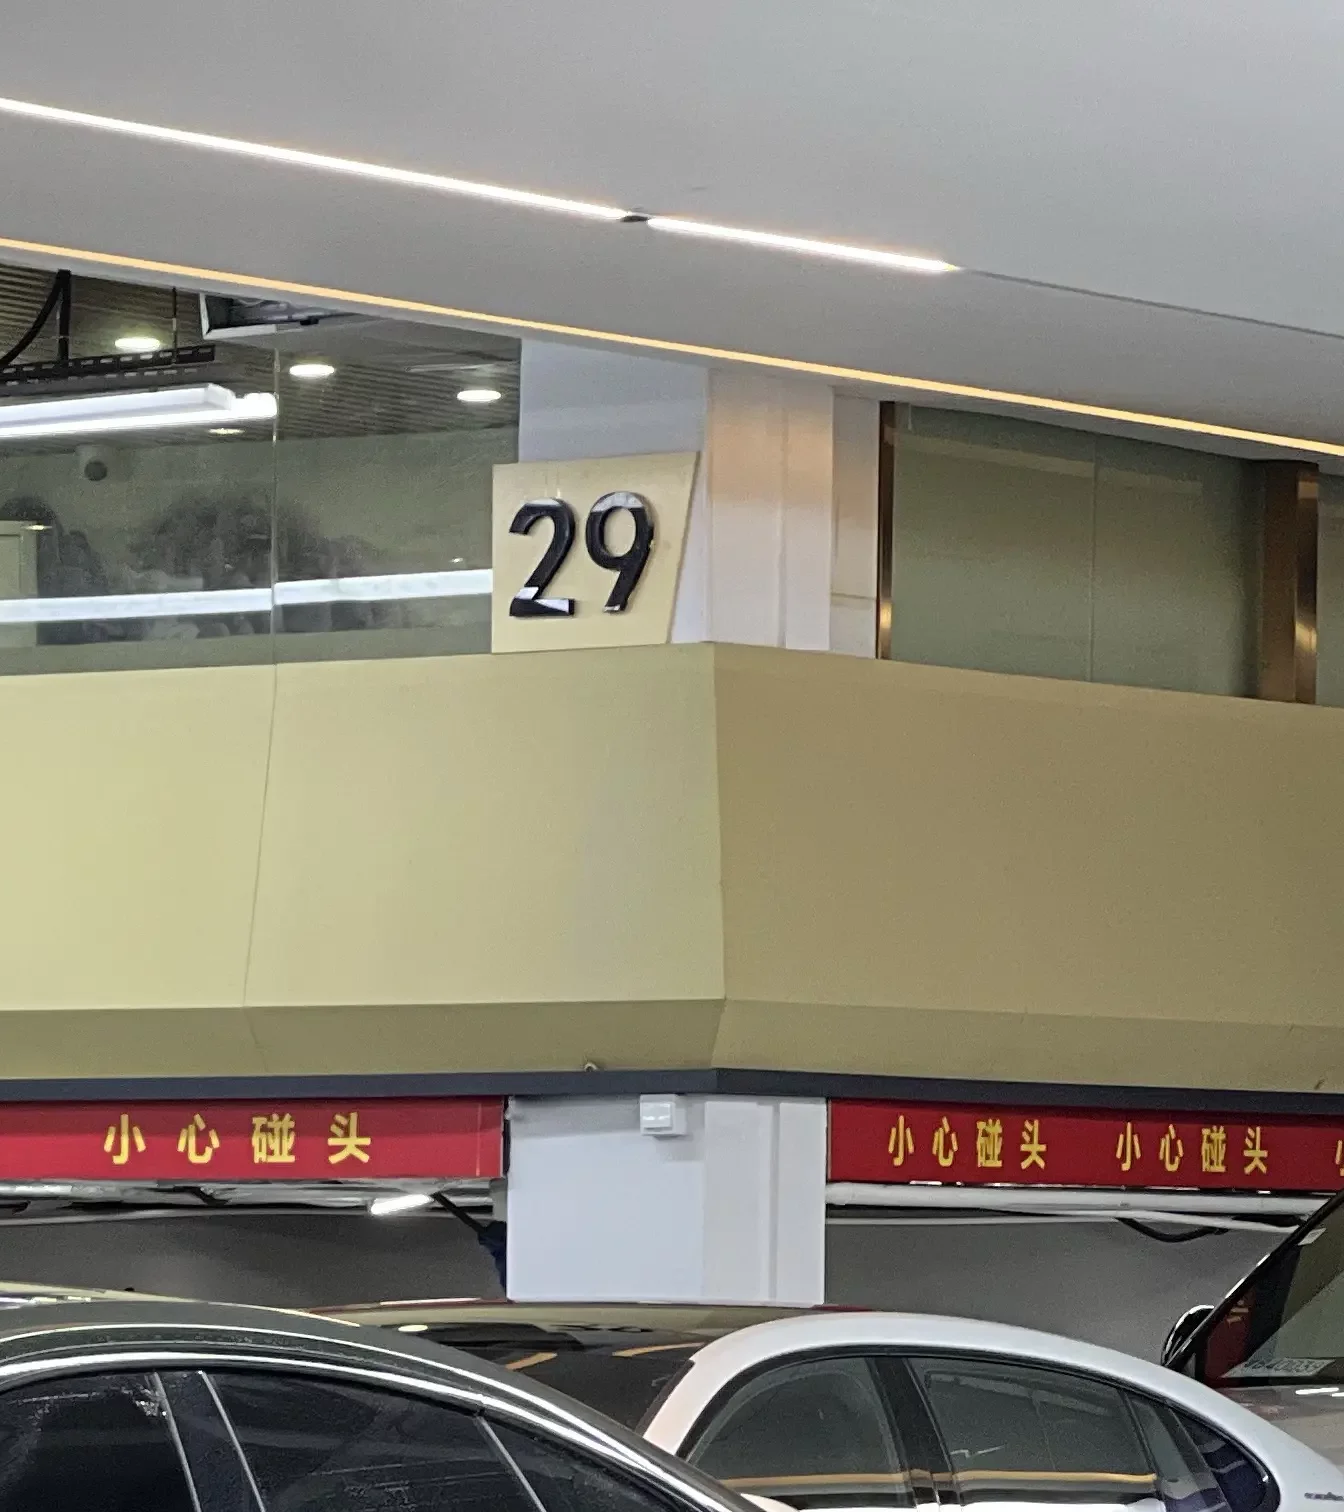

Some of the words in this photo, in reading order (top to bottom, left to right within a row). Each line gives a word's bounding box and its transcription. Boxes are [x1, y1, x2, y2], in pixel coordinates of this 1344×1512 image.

[508, 490, 655, 618] 29
[103, 1111, 372, 1166] 小心碰头
[888, 1115, 1048, 1170] 小心碰头
[1116, 1122, 1268, 1175] 小心碰头
